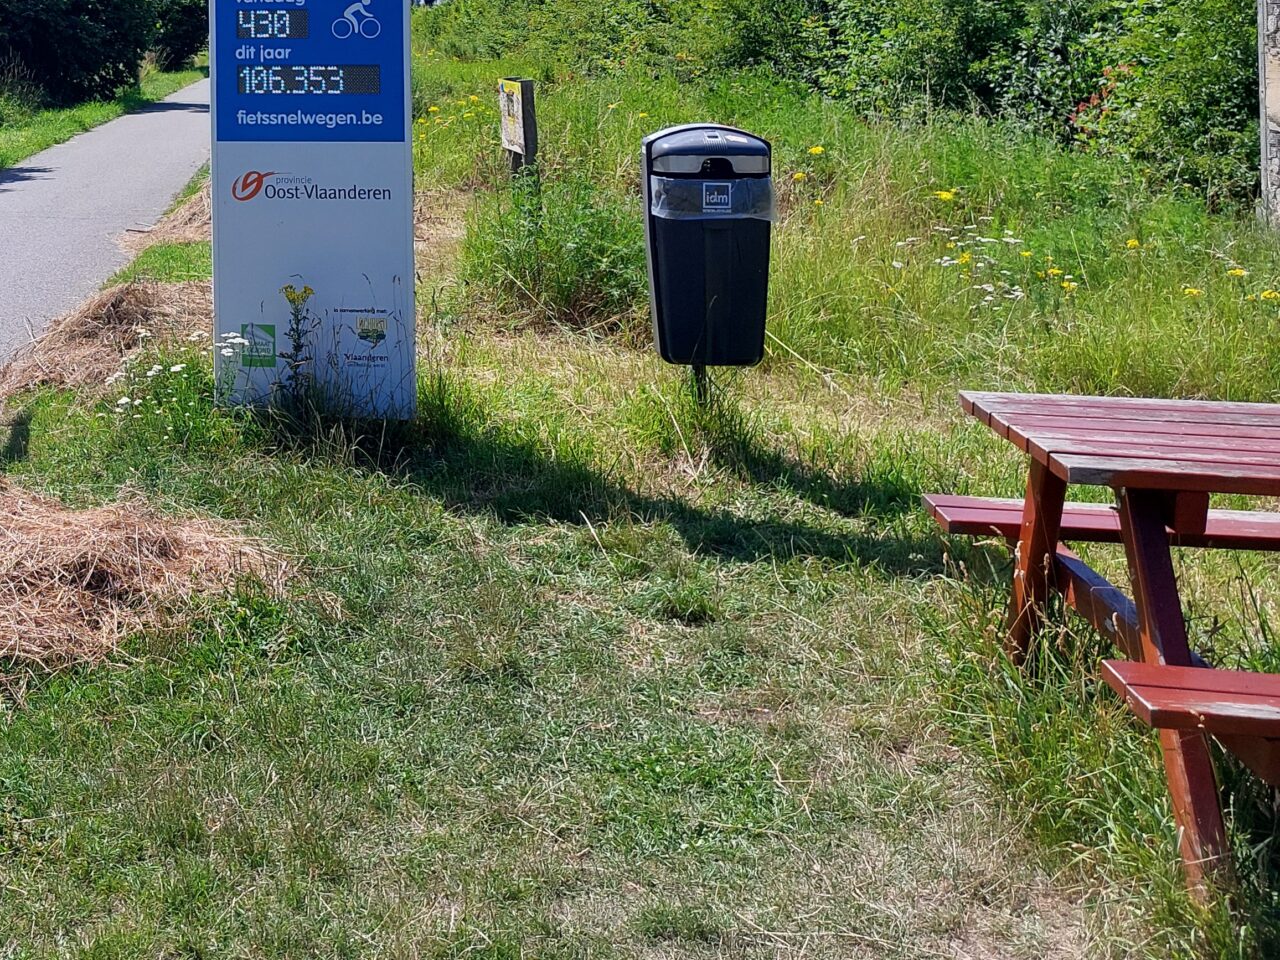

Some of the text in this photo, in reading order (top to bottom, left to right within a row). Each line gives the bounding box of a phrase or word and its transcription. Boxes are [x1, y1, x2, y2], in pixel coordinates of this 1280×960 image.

[238, 10, 290, 38] 430
[235, 45, 292, 63] dit jaar
[239, 66, 344, 94] 106.353
[236, 110, 383, 128] fietssnelwegen.be
[275, 176, 313, 186] provincie
[264, 184, 392, 200] Oost-Vlaanderen
[706, 191, 728, 203] idm
[344, 353, 389, 362] Vlaanderen
